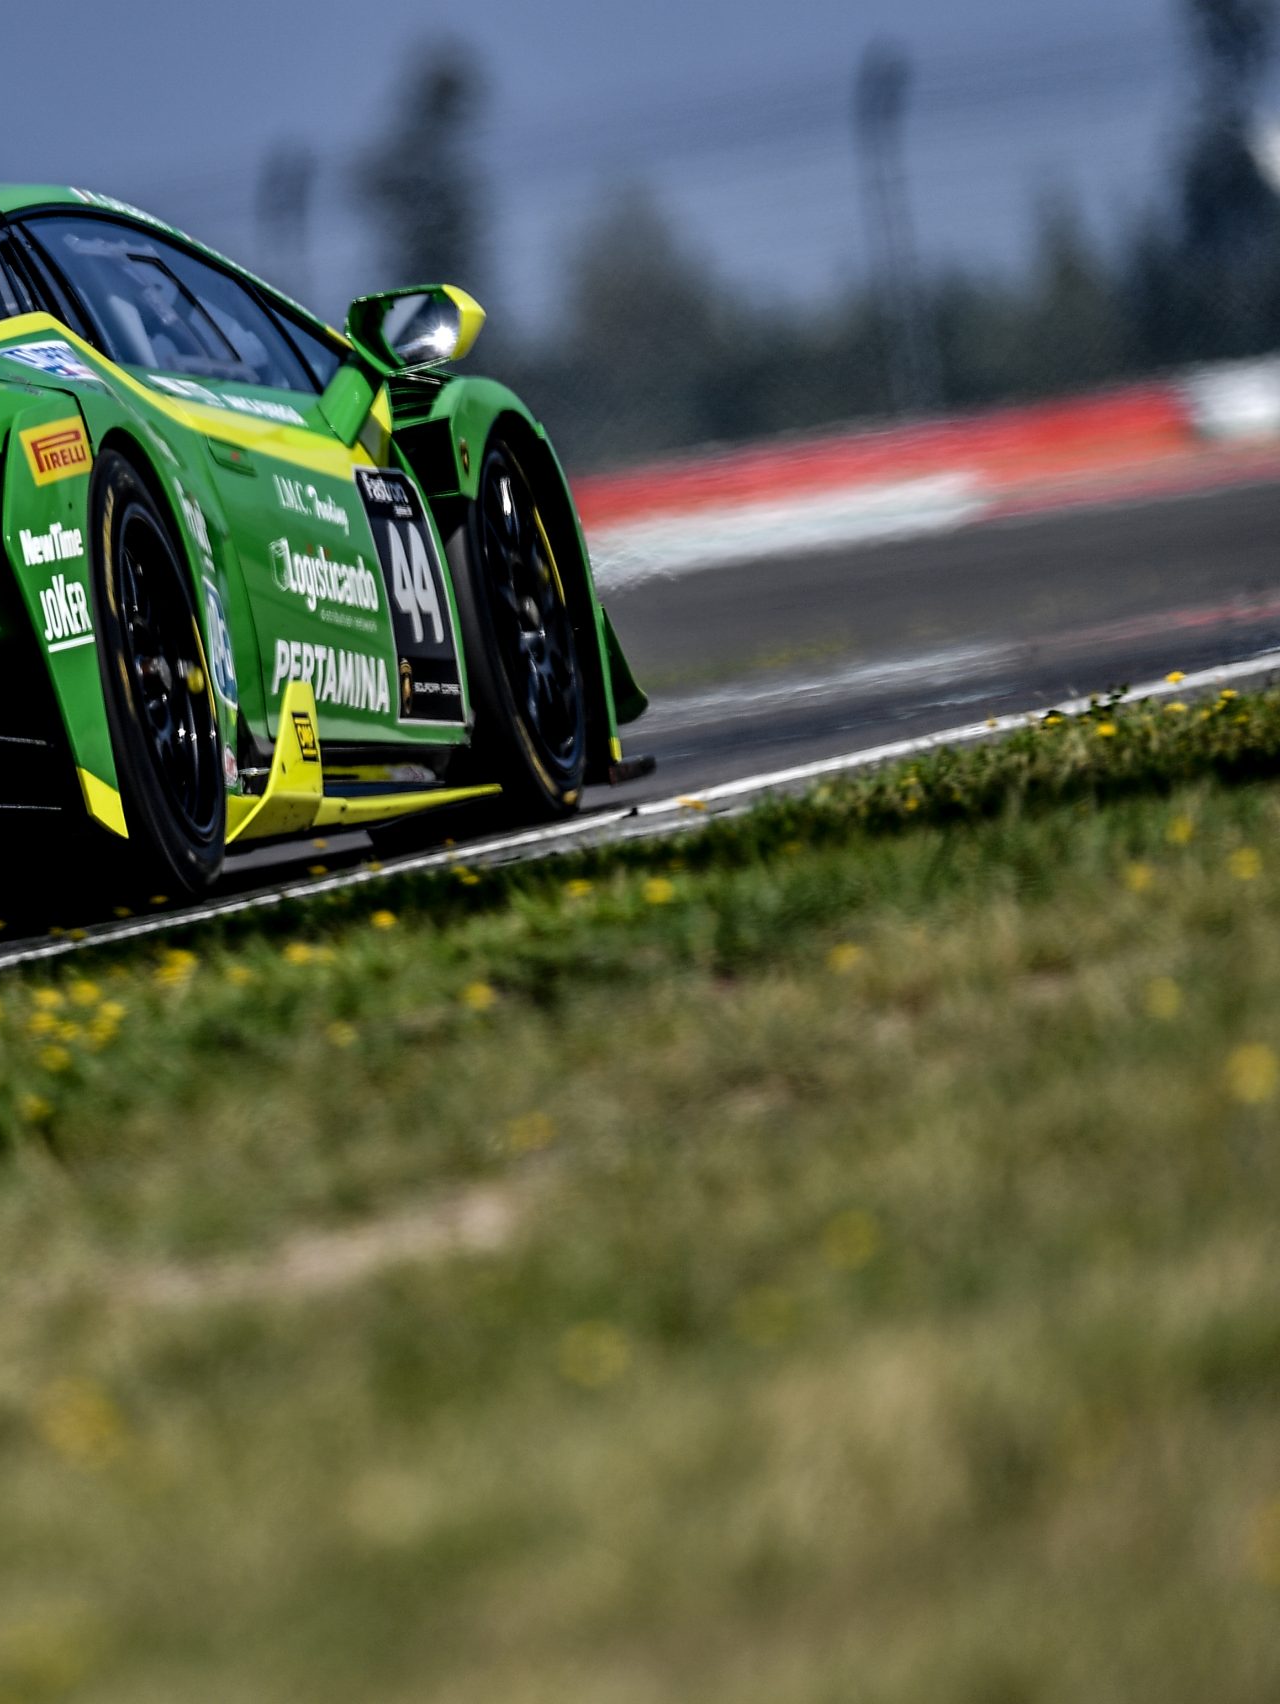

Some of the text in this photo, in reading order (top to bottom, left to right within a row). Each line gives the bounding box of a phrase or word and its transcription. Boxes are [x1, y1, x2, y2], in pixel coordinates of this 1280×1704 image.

[30, 429, 87, 473] PIRELLI
[19, 521, 84, 567] NewTime
[278, 538, 380, 613] Logisticando
[39, 573, 93, 641] JOKER
[386, 519, 444, 644] 44
[271, 638, 391, 714] PERTAMINA
